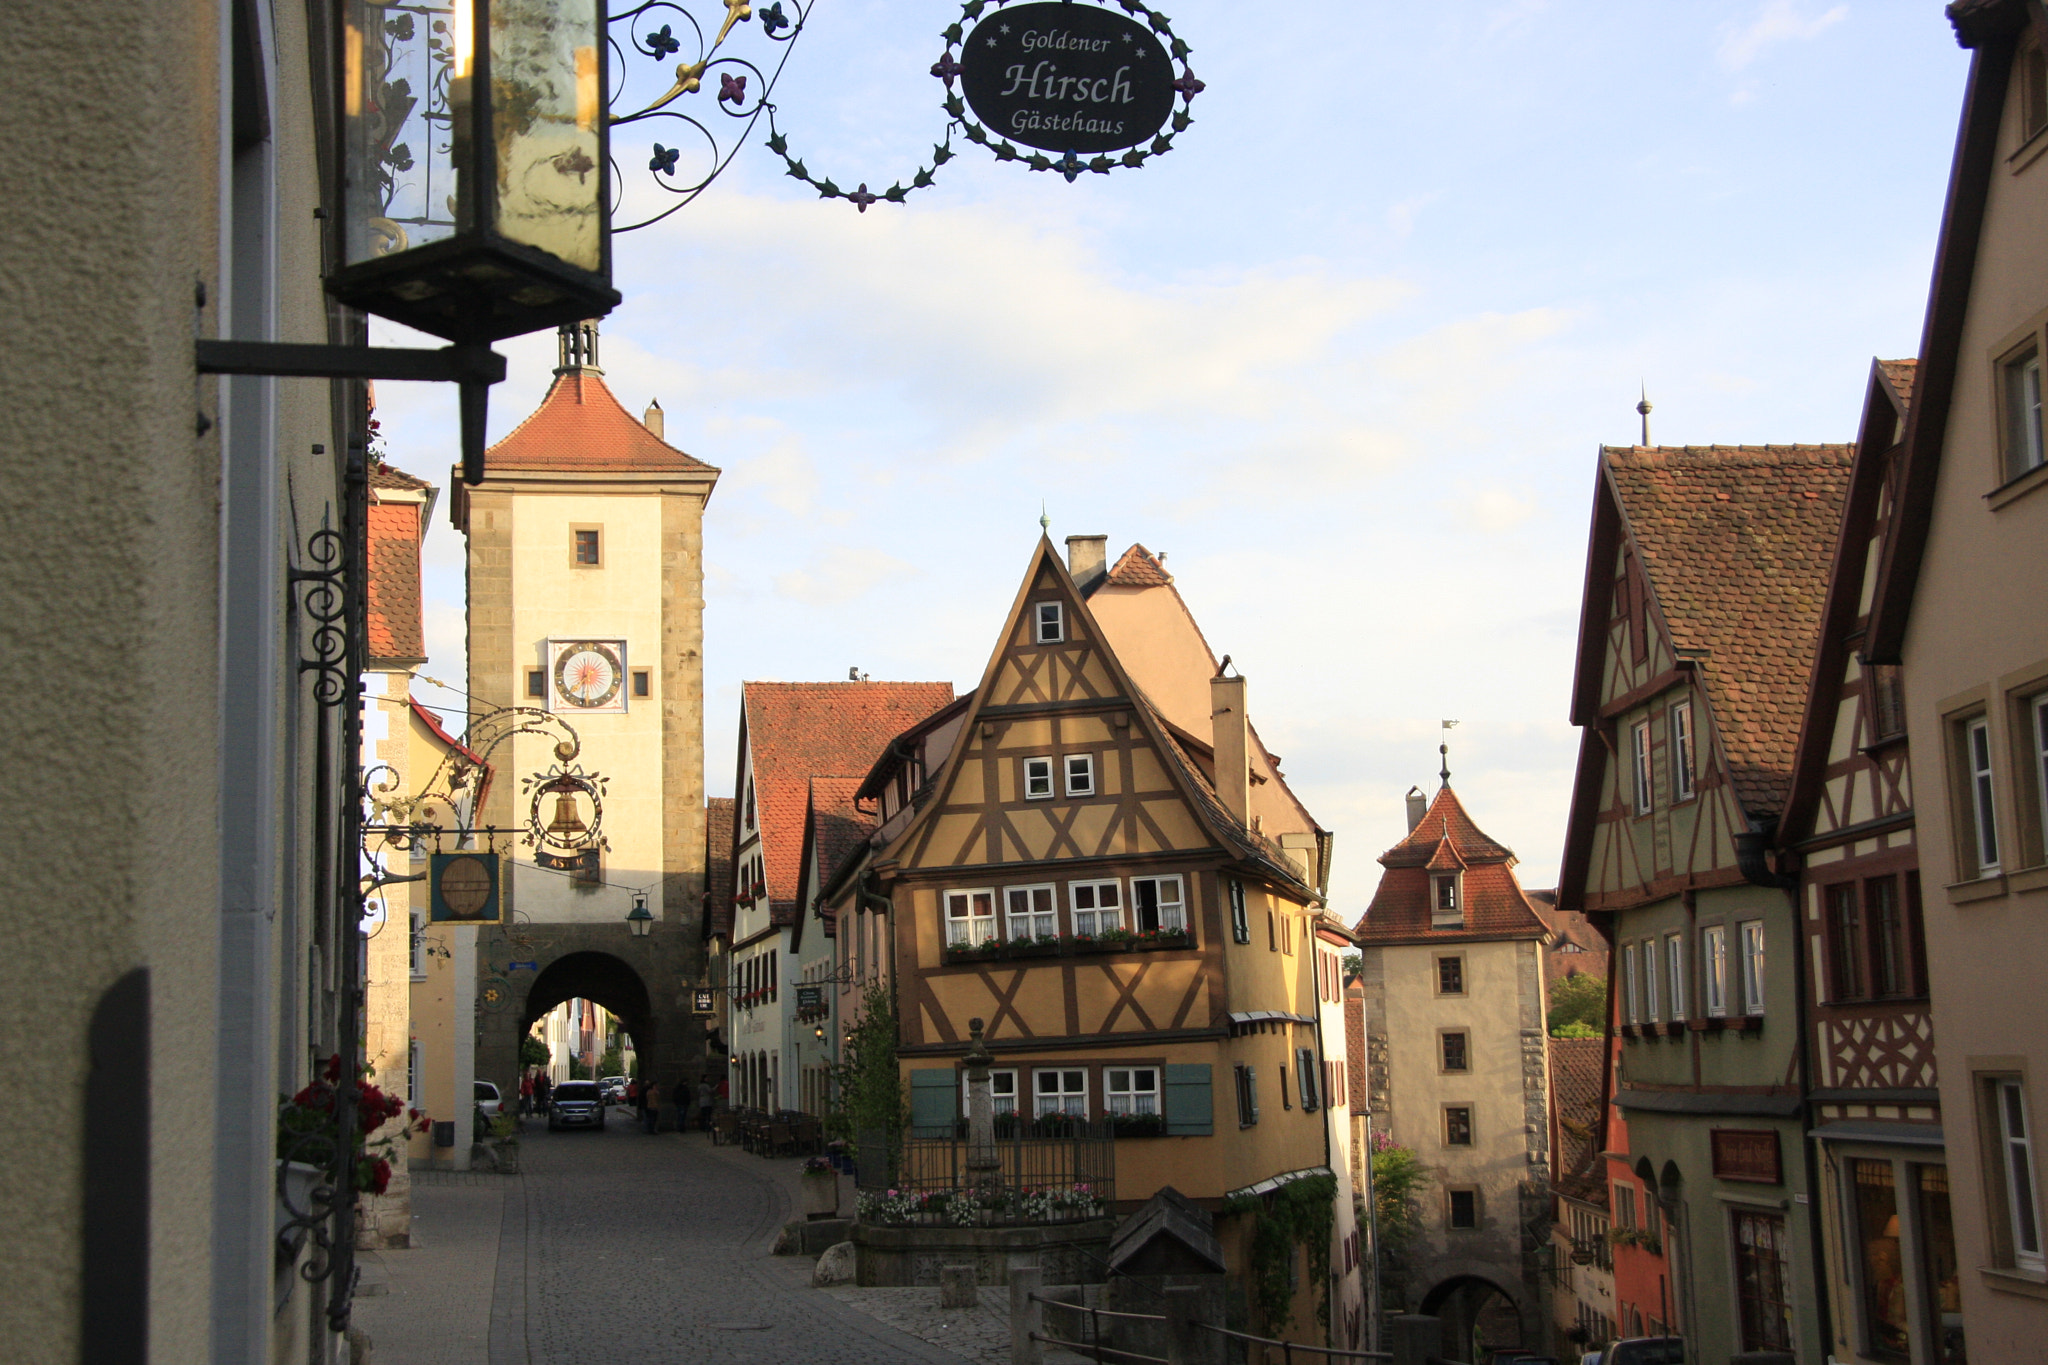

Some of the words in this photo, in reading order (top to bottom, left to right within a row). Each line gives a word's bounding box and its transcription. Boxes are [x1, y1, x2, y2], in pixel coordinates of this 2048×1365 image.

[1021, 28, 1111, 53] Goldener
[1000, 60, 1135, 104] Hirsch
[1011, 109, 1124, 135] Gästehaus
